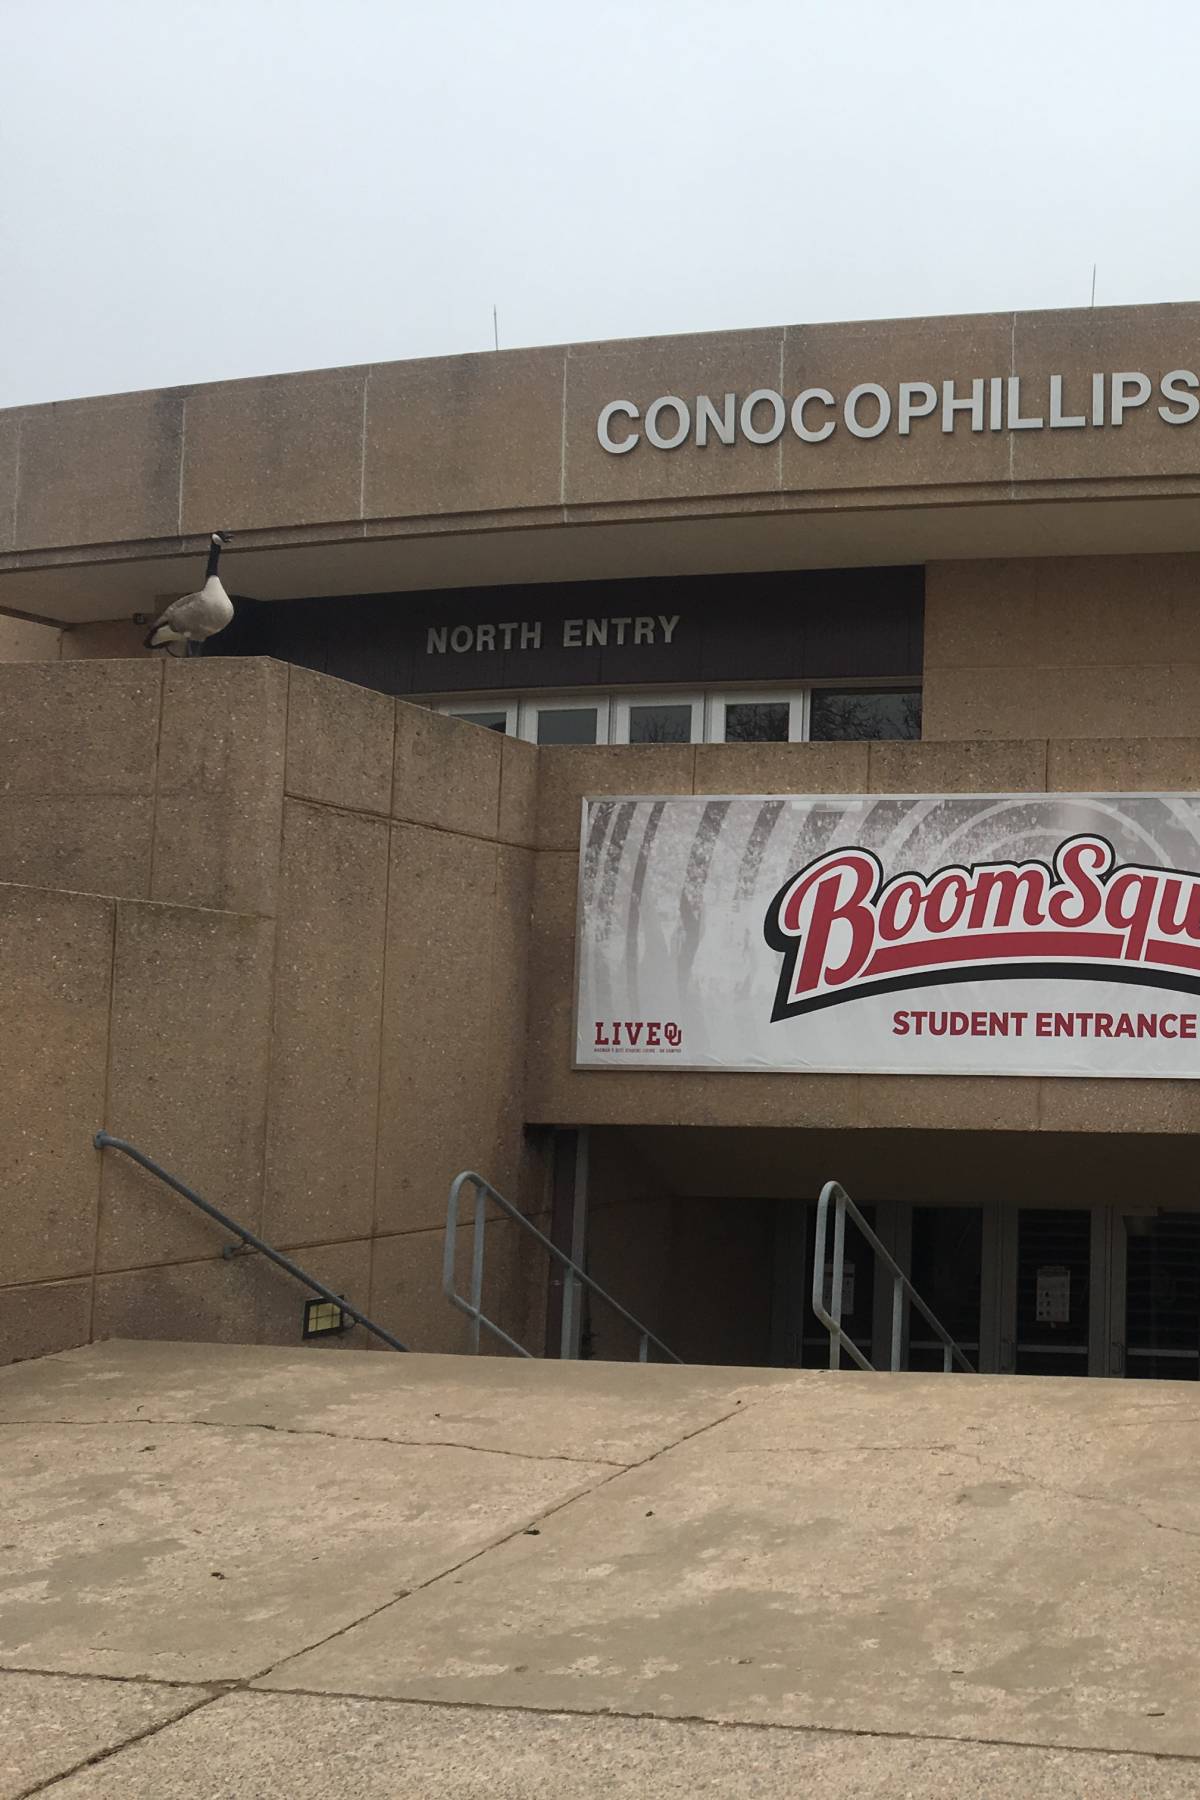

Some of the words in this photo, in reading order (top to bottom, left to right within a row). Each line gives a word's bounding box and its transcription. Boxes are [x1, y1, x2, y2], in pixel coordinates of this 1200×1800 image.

[597, 369, 1200, 454] CONOCOPHILLIPS
[426, 621, 542, 654] NORTH
[563, 615, 680, 647] ENTRY
[892, 1010, 1029, 1037] STUDENT
[1035, 1012, 1198, 1039] ENTRANCE
